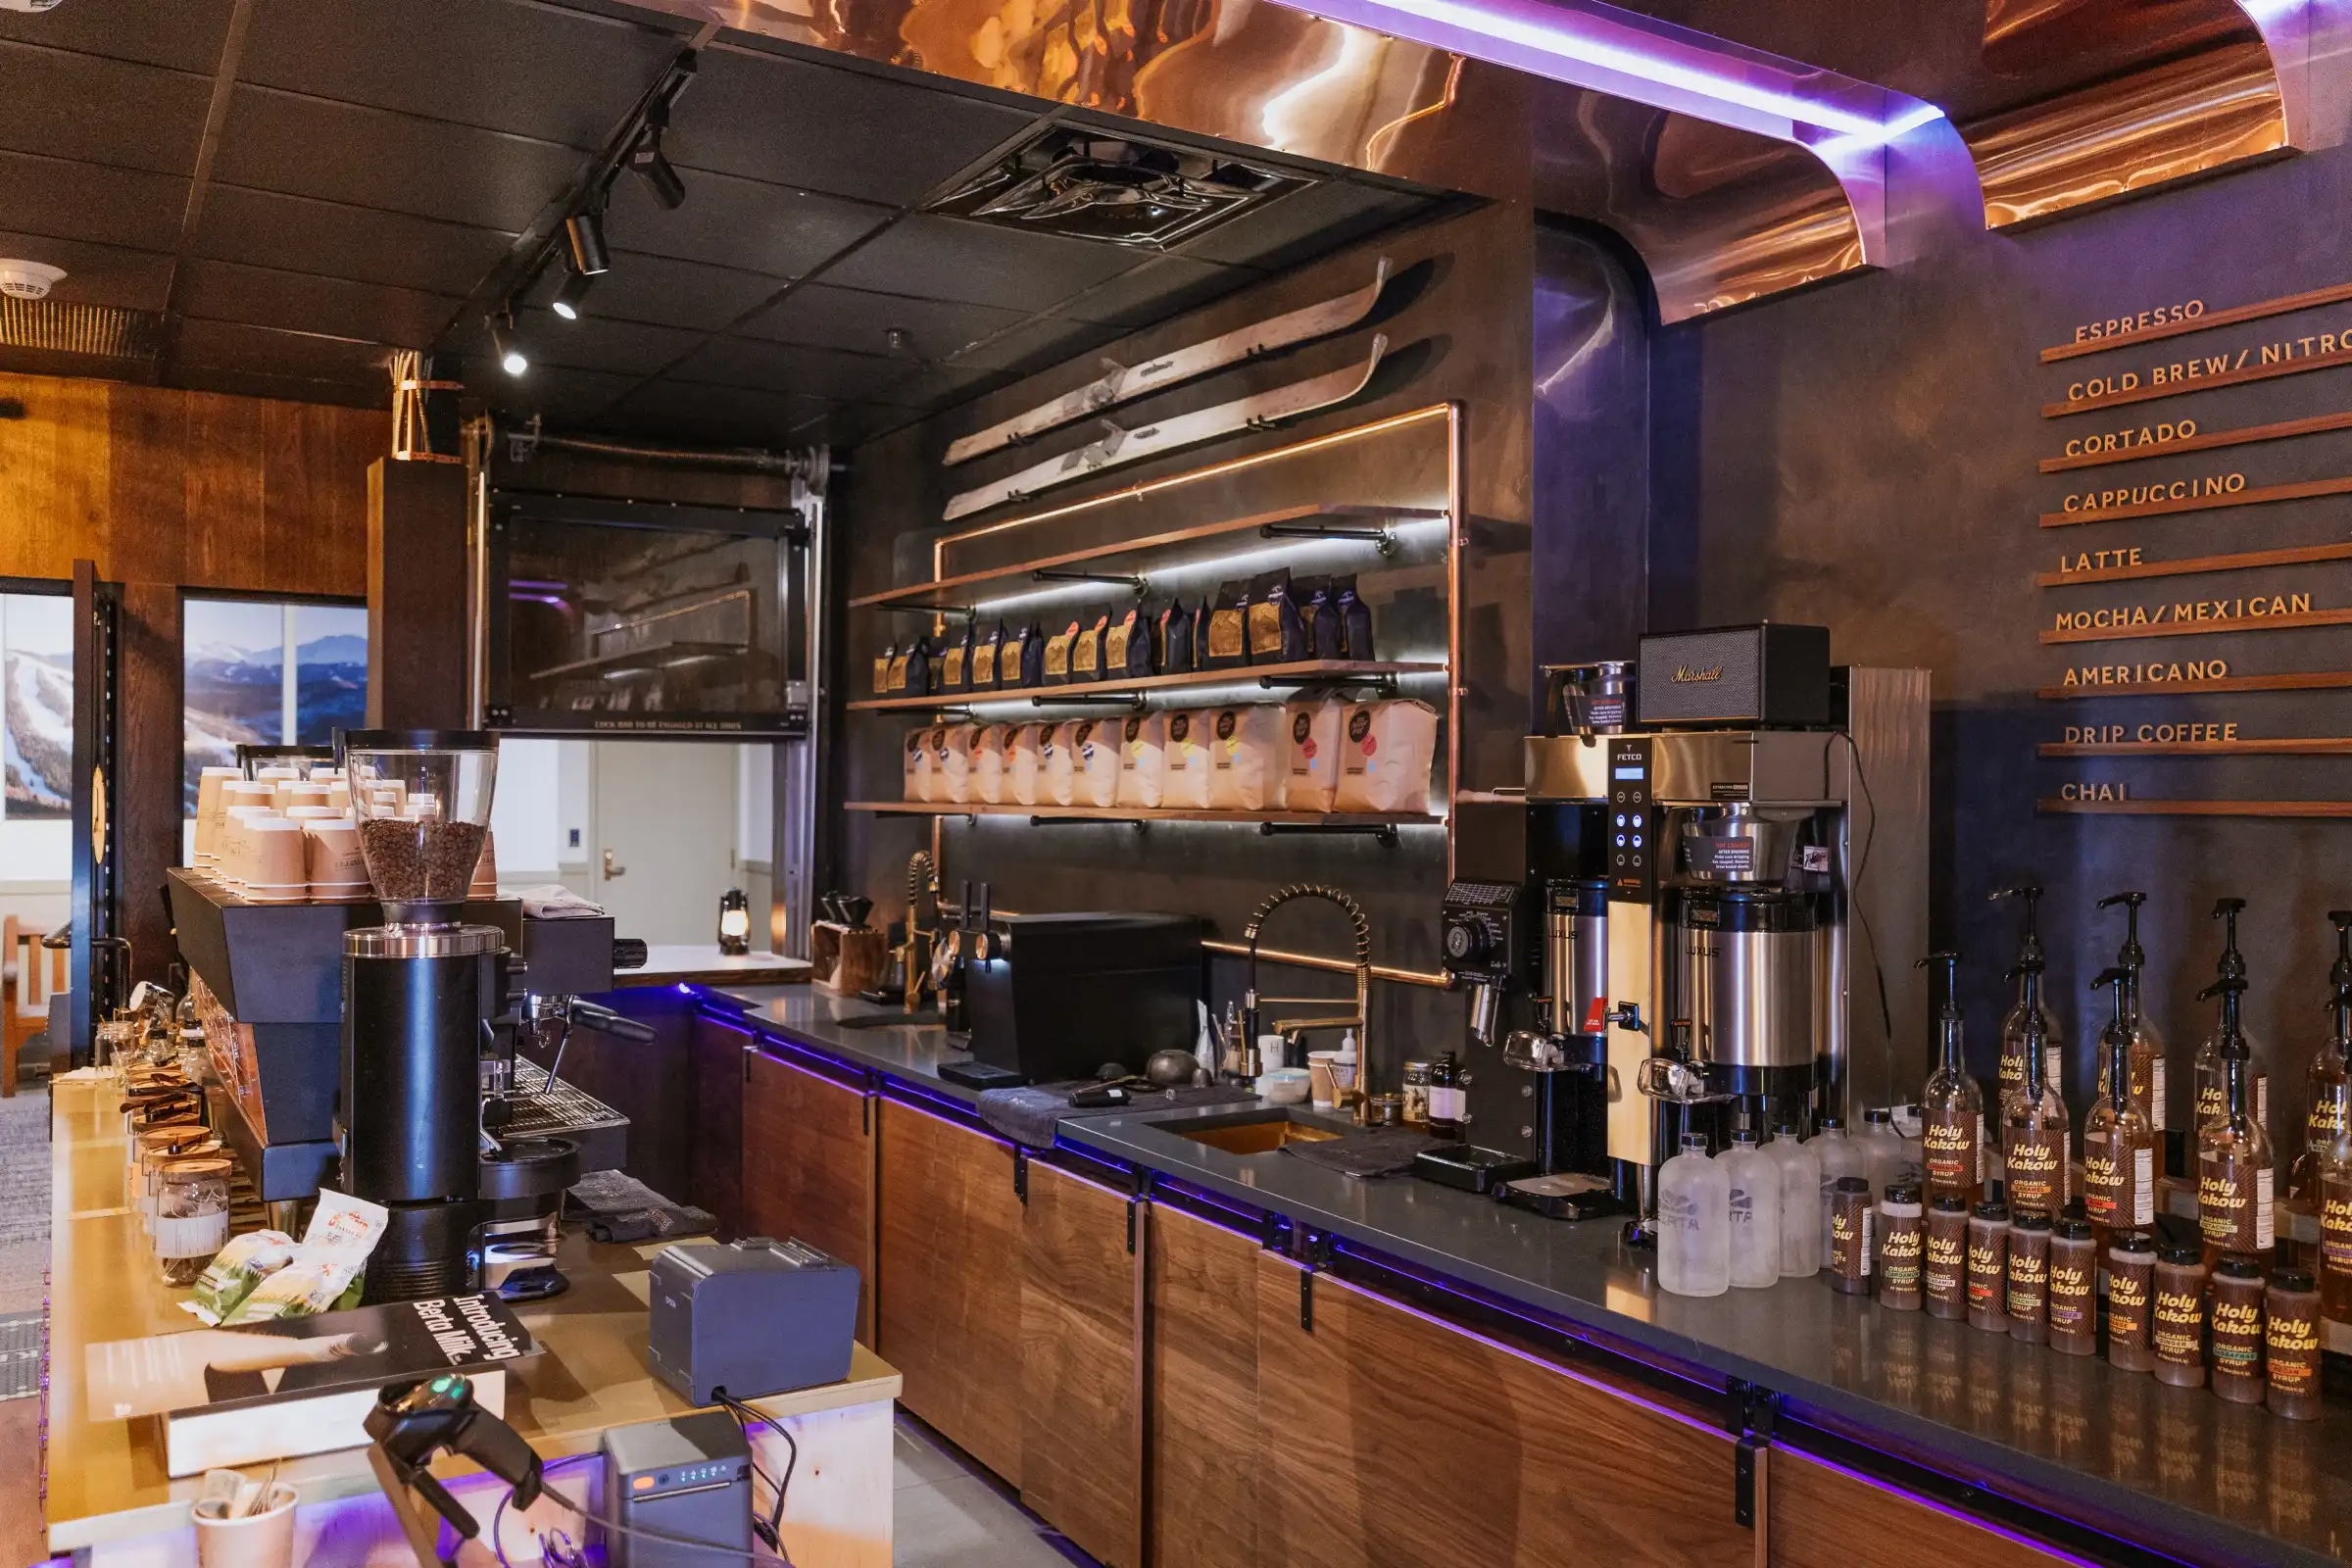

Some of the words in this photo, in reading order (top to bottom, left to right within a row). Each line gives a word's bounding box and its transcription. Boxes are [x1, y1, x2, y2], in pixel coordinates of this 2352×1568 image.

[2075, 300, 2204, 343] ESPRESSO
[2069, 372, 2139, 401] COLD
[2066, 419, 2196, 457] CORTADO
[2064, 473, 2245, 513] CAPPUCCINO
[2061, 548, 2142, 573] LATTE
[1671, 664, 1723, 683] Marshall
[2063, 660, 2227, 686] AMERICANO
[2065, 726, 2125, 744] DRIP
[2137, 723, 2237, 742] COFFEE
[2061, 783, 2125, 801] CHAI
[2196, 1101, 2221, 1115] Kak
[2316, 1100, 2347, 1114] Hol
[1929, 1125, 1963, 1141] Holy
[1924, 1137, 1970, 1150] Kakow
[2014, 1144, 2050, 1161] Holy
[2007, 1157, 2058, 1171] Kakow
[2085, 1156, 2116, 1175] Holy
[2084, 1171, 2125, 1186] akow
[2201, 1176, 2236, 1197] Holy
[2325, 1200, 2352, 1216] Hol
[1887, 1231, 1920, 1247] Holy
[1928, 1236, 1956, 1254] Holy
[1928, 1251, 1962, 1264] akow
[2009, 1254, 2040, 1273] Holy
[2009, 1269, 2047, 1283] akow
[2050, 1264, 2083, 1285] Holy
[2050, 1282, 2089, 1296] akow
[2110, 1290, 2146, 1306] kow
[2158, 1292, 2196, 1312] Holy
[413, 1298, 454, 1332] Berta
[2216, 1302, 2258, 1323] Holy
[453, 1294, 520, 1360] Introducing
[2157, 1330, 2191, 1341] ORGANIC
[2268, 1316, 2311, 1338] Holy
[2160, 1346, 2185, 1354] SYRUP
[2216, 1343, 2254, 1352] ORGANIC
[2274, 1373, 2301, 1383] SYRUP
